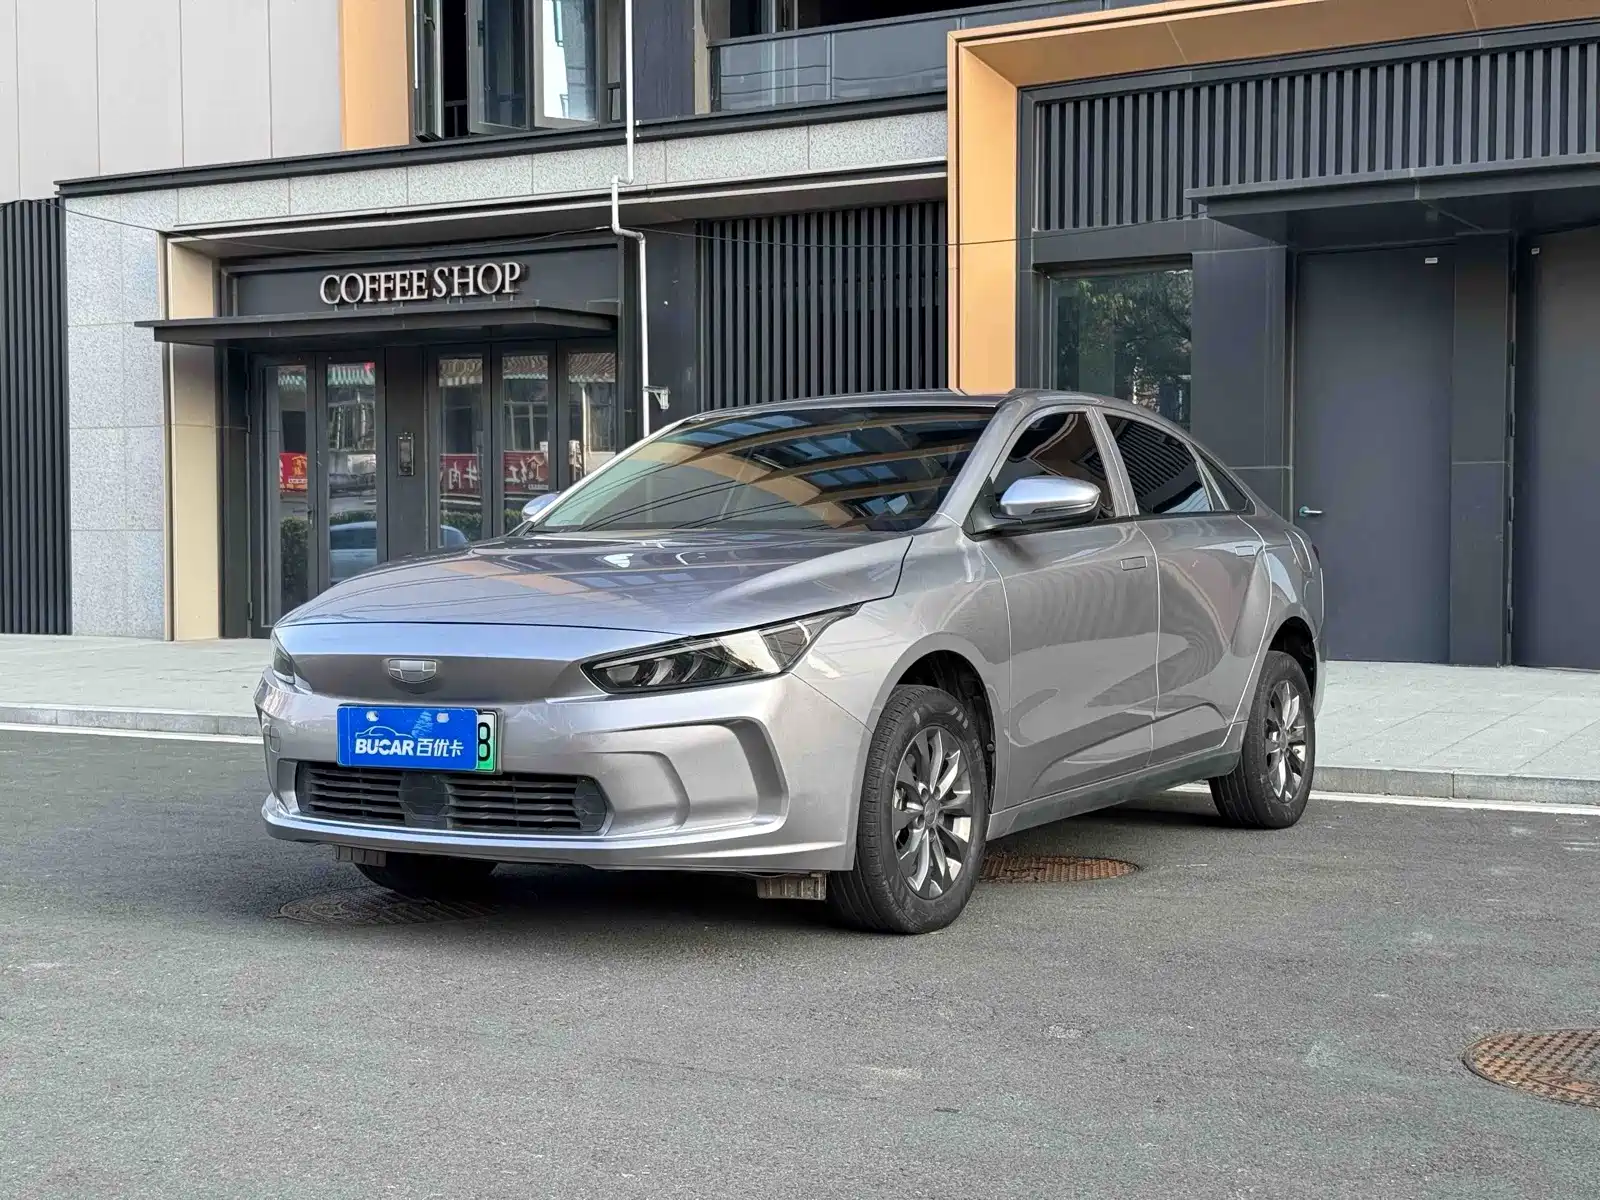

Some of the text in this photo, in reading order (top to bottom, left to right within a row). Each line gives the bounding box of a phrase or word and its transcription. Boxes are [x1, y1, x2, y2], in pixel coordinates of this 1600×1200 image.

[320, 262, 521, 304] COFFEE SHOP
[355, 738, 464, 757] BUCAR 百优卡
[477, 722, 491, 762] 8
